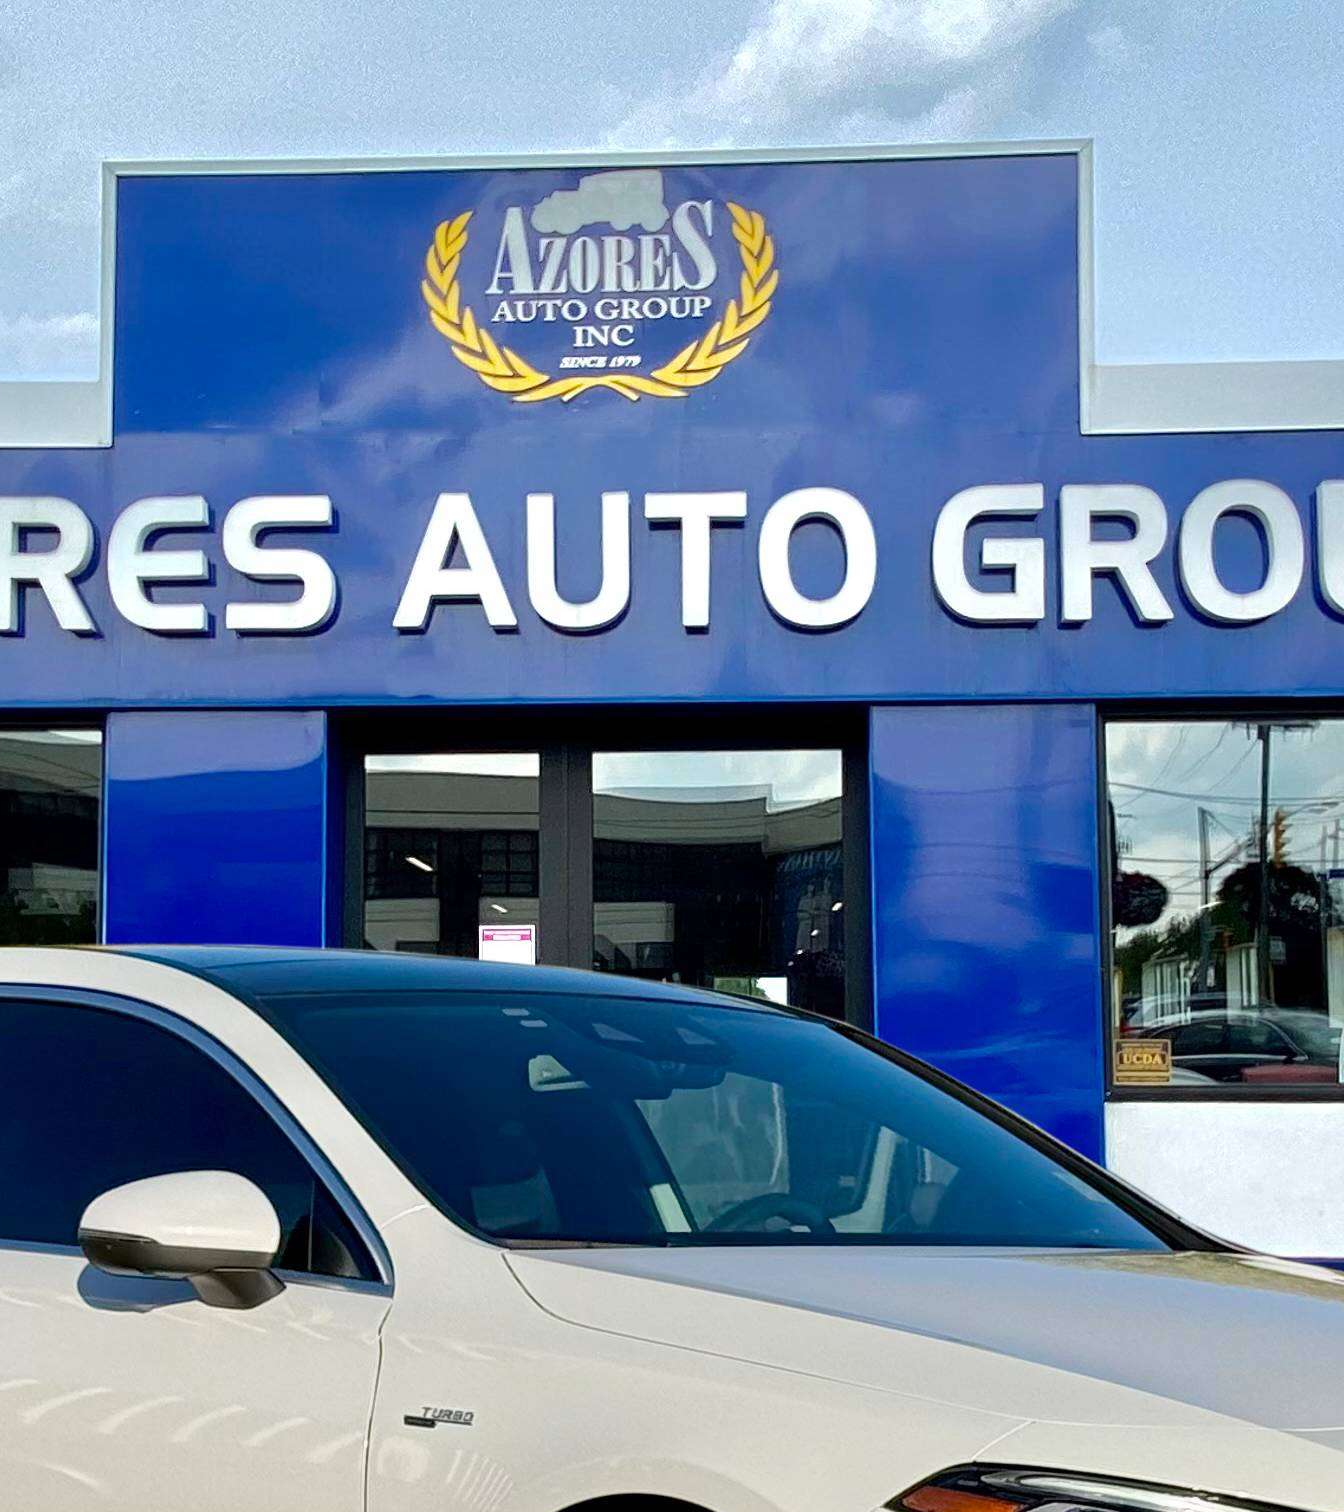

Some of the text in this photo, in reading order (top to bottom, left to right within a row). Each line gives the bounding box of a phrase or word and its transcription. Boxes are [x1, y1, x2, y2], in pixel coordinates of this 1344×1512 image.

[485, 200, 717, 294] AZORES
[491, 296, 712, 323] AUTO GROUP
[573, 325, 635, 347] INC
[559, 355, 641, 369] SINCE 1979
[392, 486, 877, 633] AUTO
[1122, 1053, 1163, 1065] UCDA
[421, 1407, 474, 1422] TURBO
